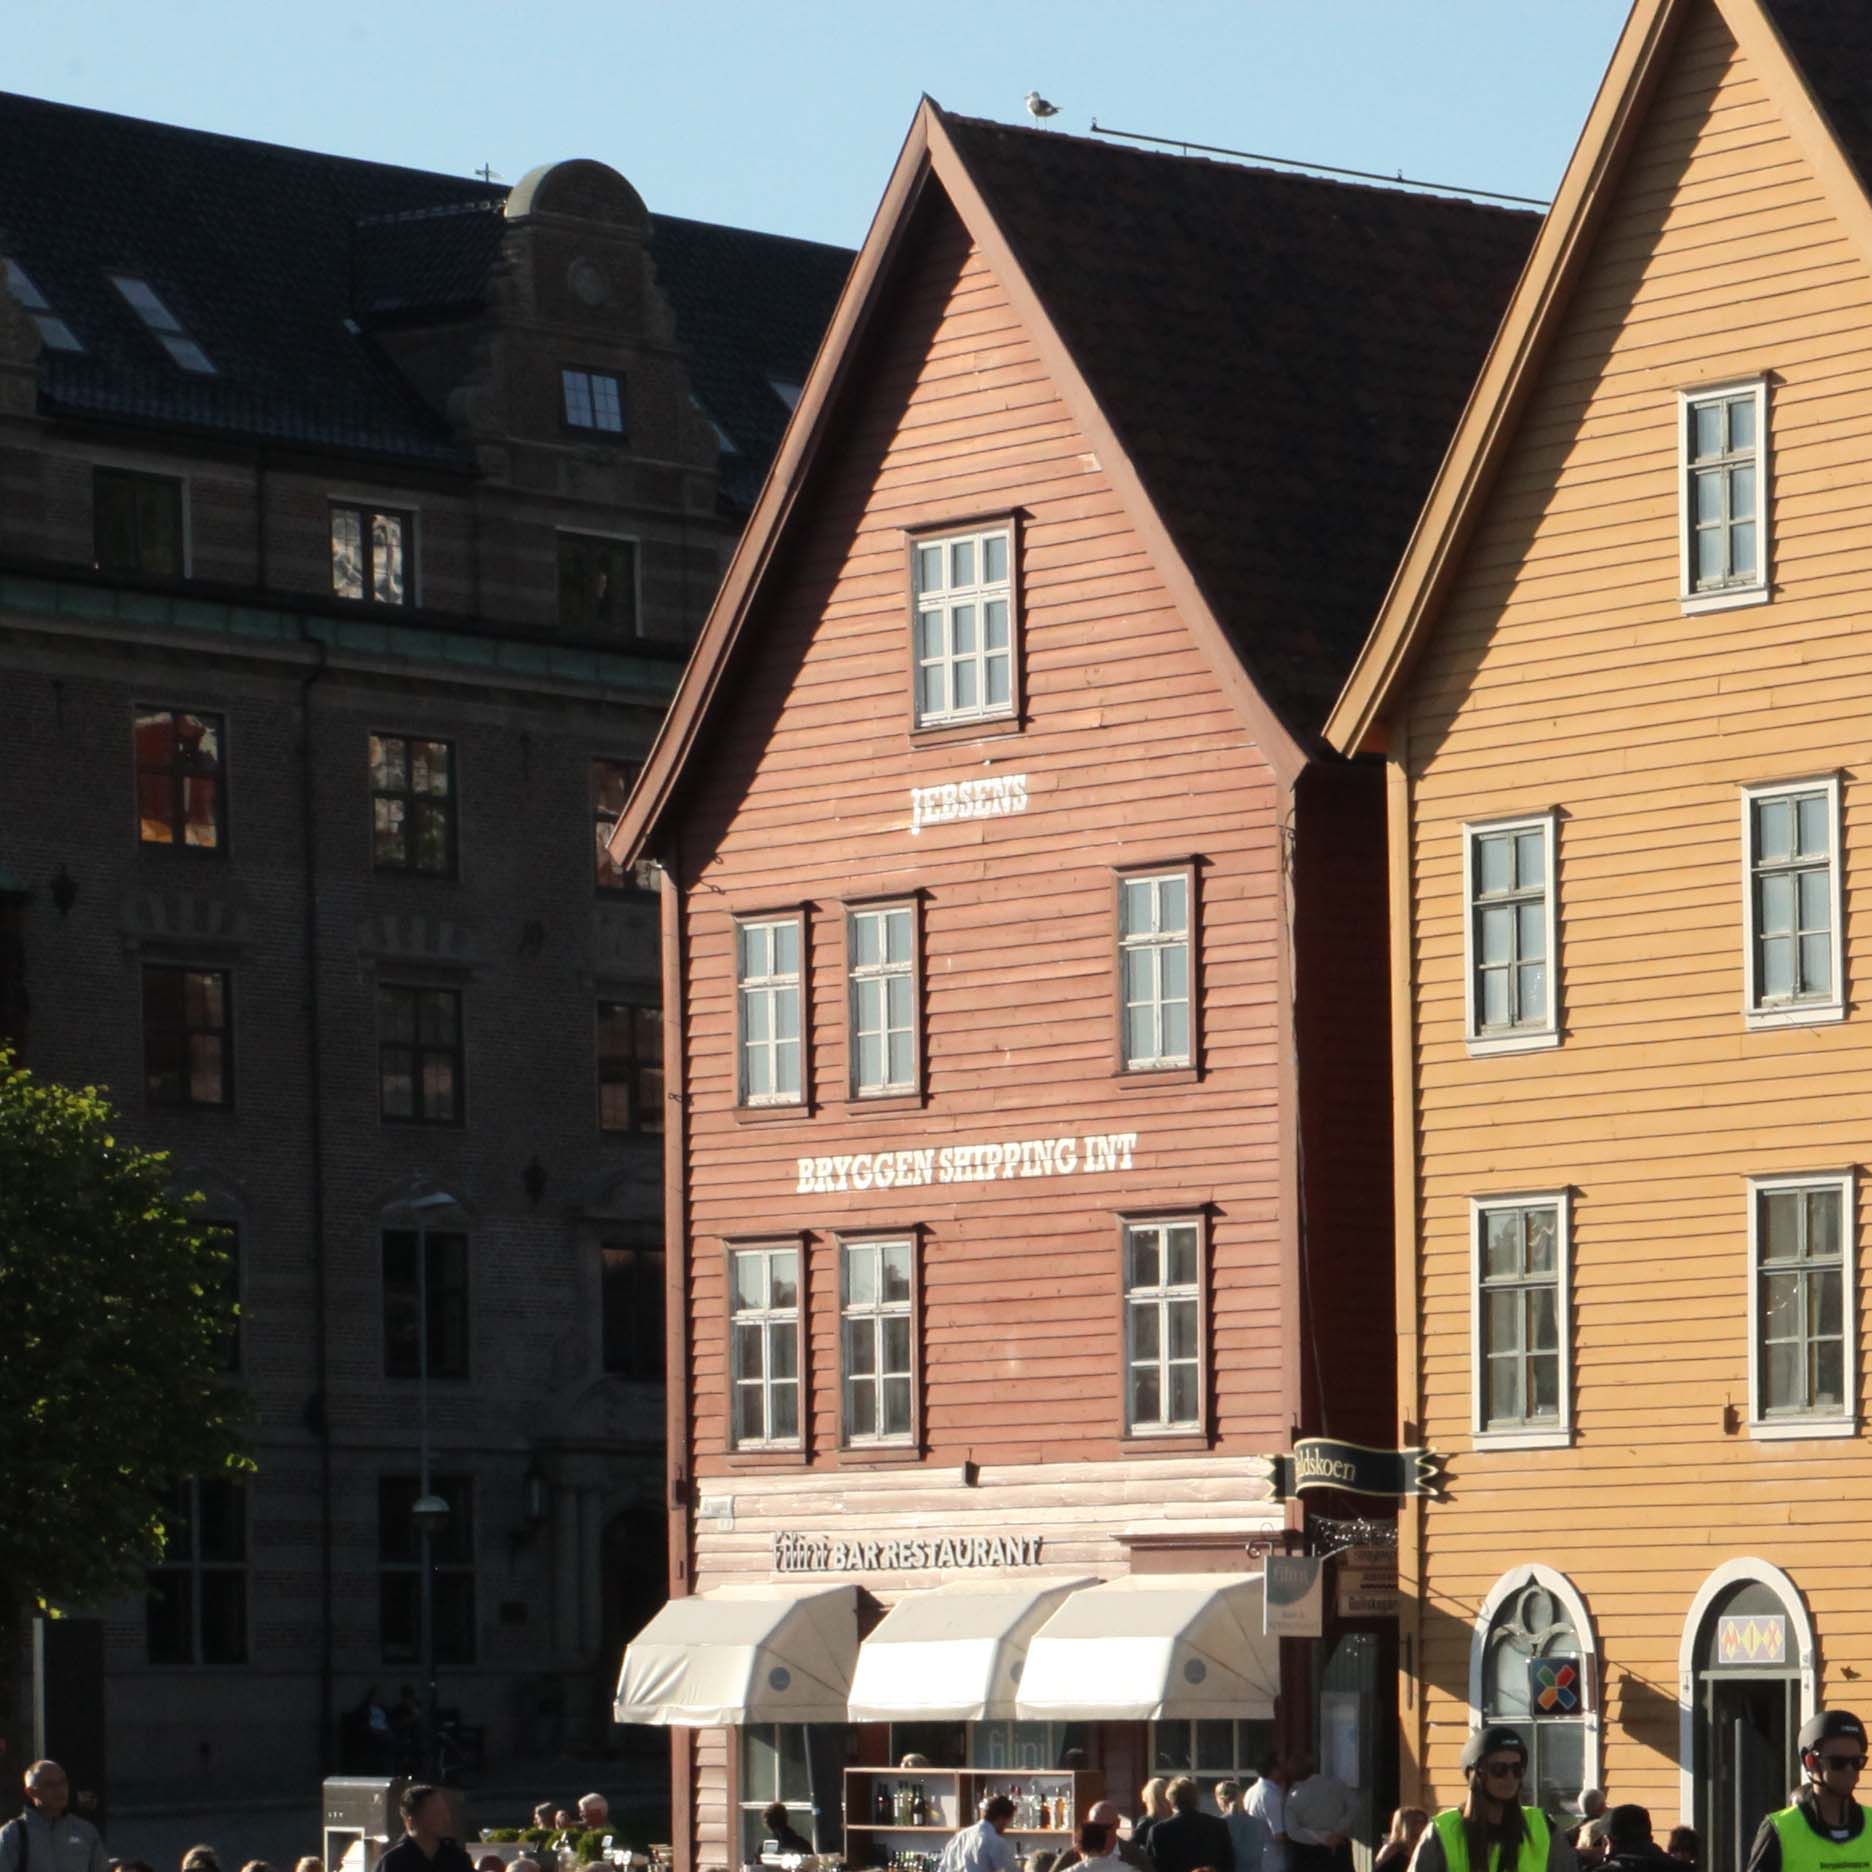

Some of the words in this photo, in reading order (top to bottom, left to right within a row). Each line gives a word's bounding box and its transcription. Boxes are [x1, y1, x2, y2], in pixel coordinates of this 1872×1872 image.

[911, 773, 1029, 836] JEBSENS
[796, 1149, 936, 1194] BRYGGEN
[938, 1137, 1077, 1183] SHIPPING
[1083, 1132, 1139, 1172] INT
[833, 1540, 882, 1571] BAR
[879, 1536, 1043, 1570] RESTAURANT
